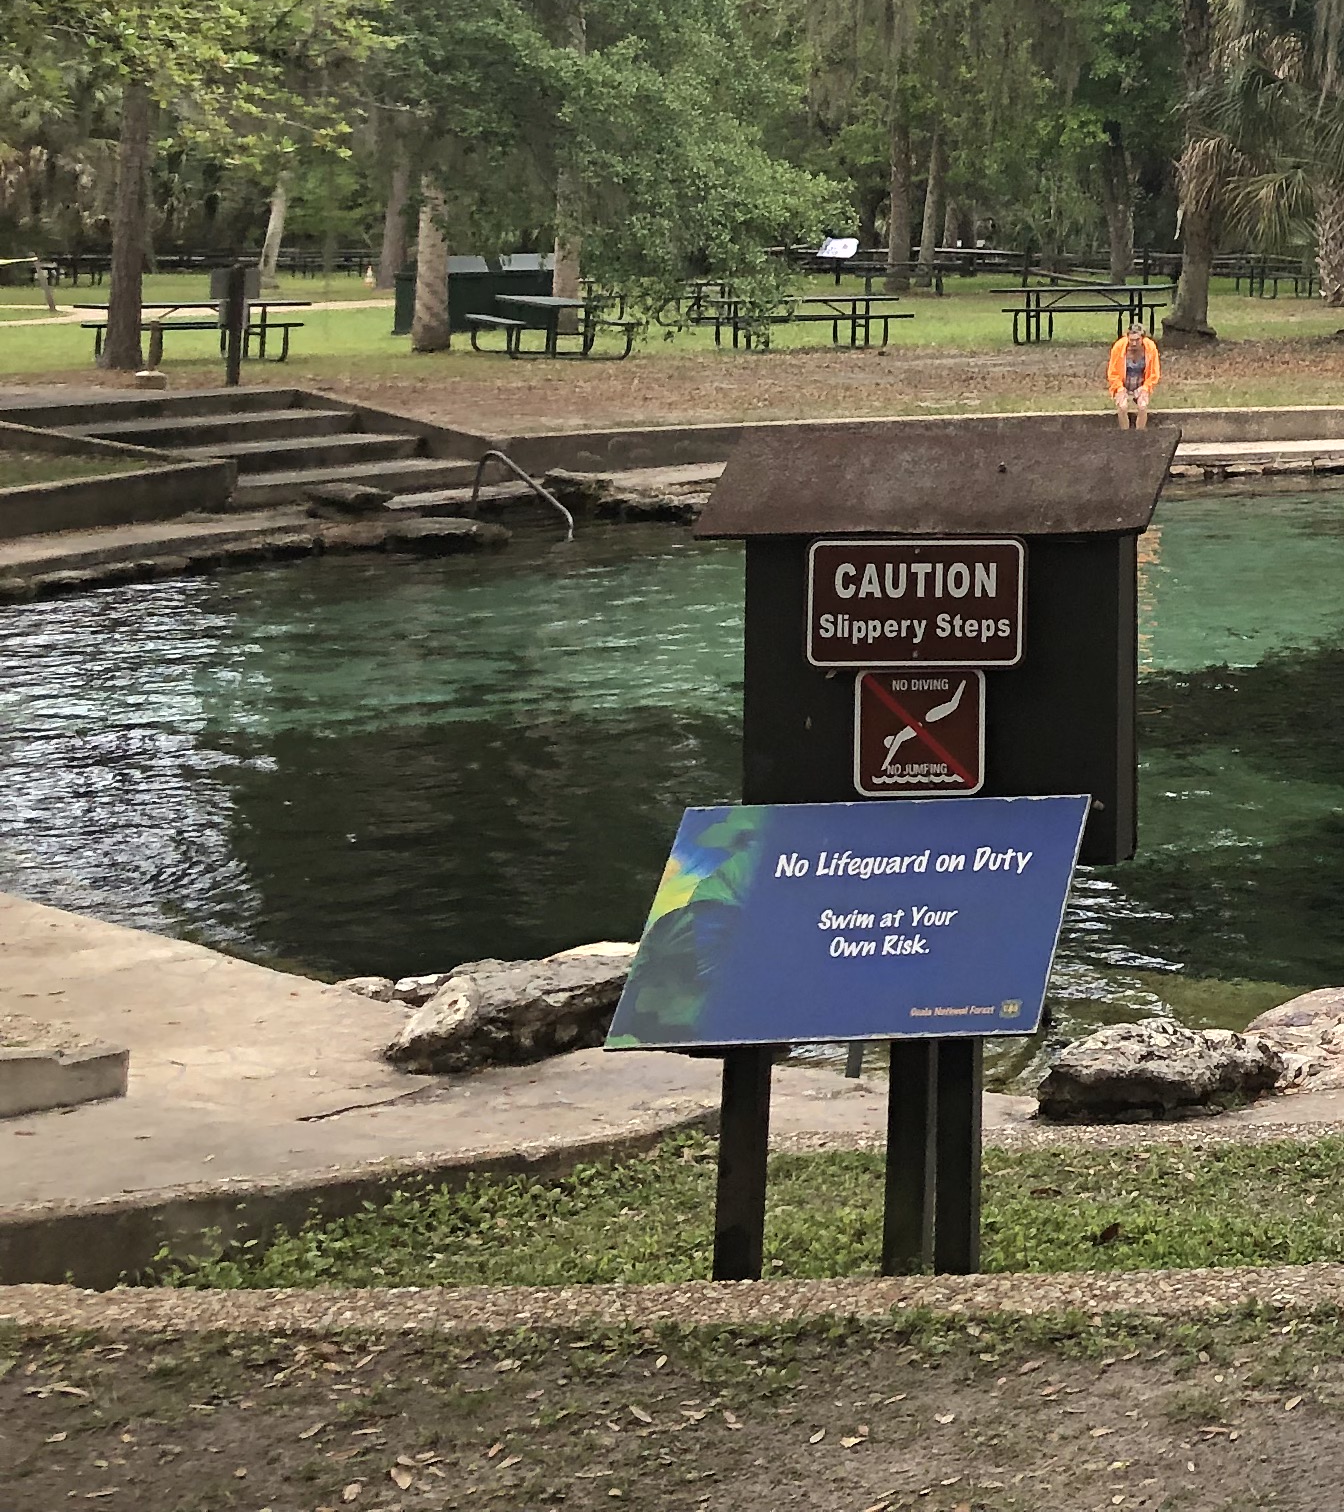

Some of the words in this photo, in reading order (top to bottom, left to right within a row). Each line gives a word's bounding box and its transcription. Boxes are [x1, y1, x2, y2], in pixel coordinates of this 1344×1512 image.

[834, 562, 997, 598] CAUTION
[819, 613, 927, 645] Slippery
[935, 612, 1011, 643] Steps
[892, 679, 908, 691] NO
[911, 678, 949, 691] DIVING
[887, 764, 902, 775] NO
[775, 853, 809, 879] No
[816, 848, 927, 878] Lifeguard
[936, 852, 965, 873] on
[973, 846, 1033, 875] Duty
[817, 908, 875, 930] Swim
[879, 909, 905, 929] at
[911, 905, 958, 928] Your
[829, 937, 875, 958] Own
[881, 934, 931, 956] Risk.
